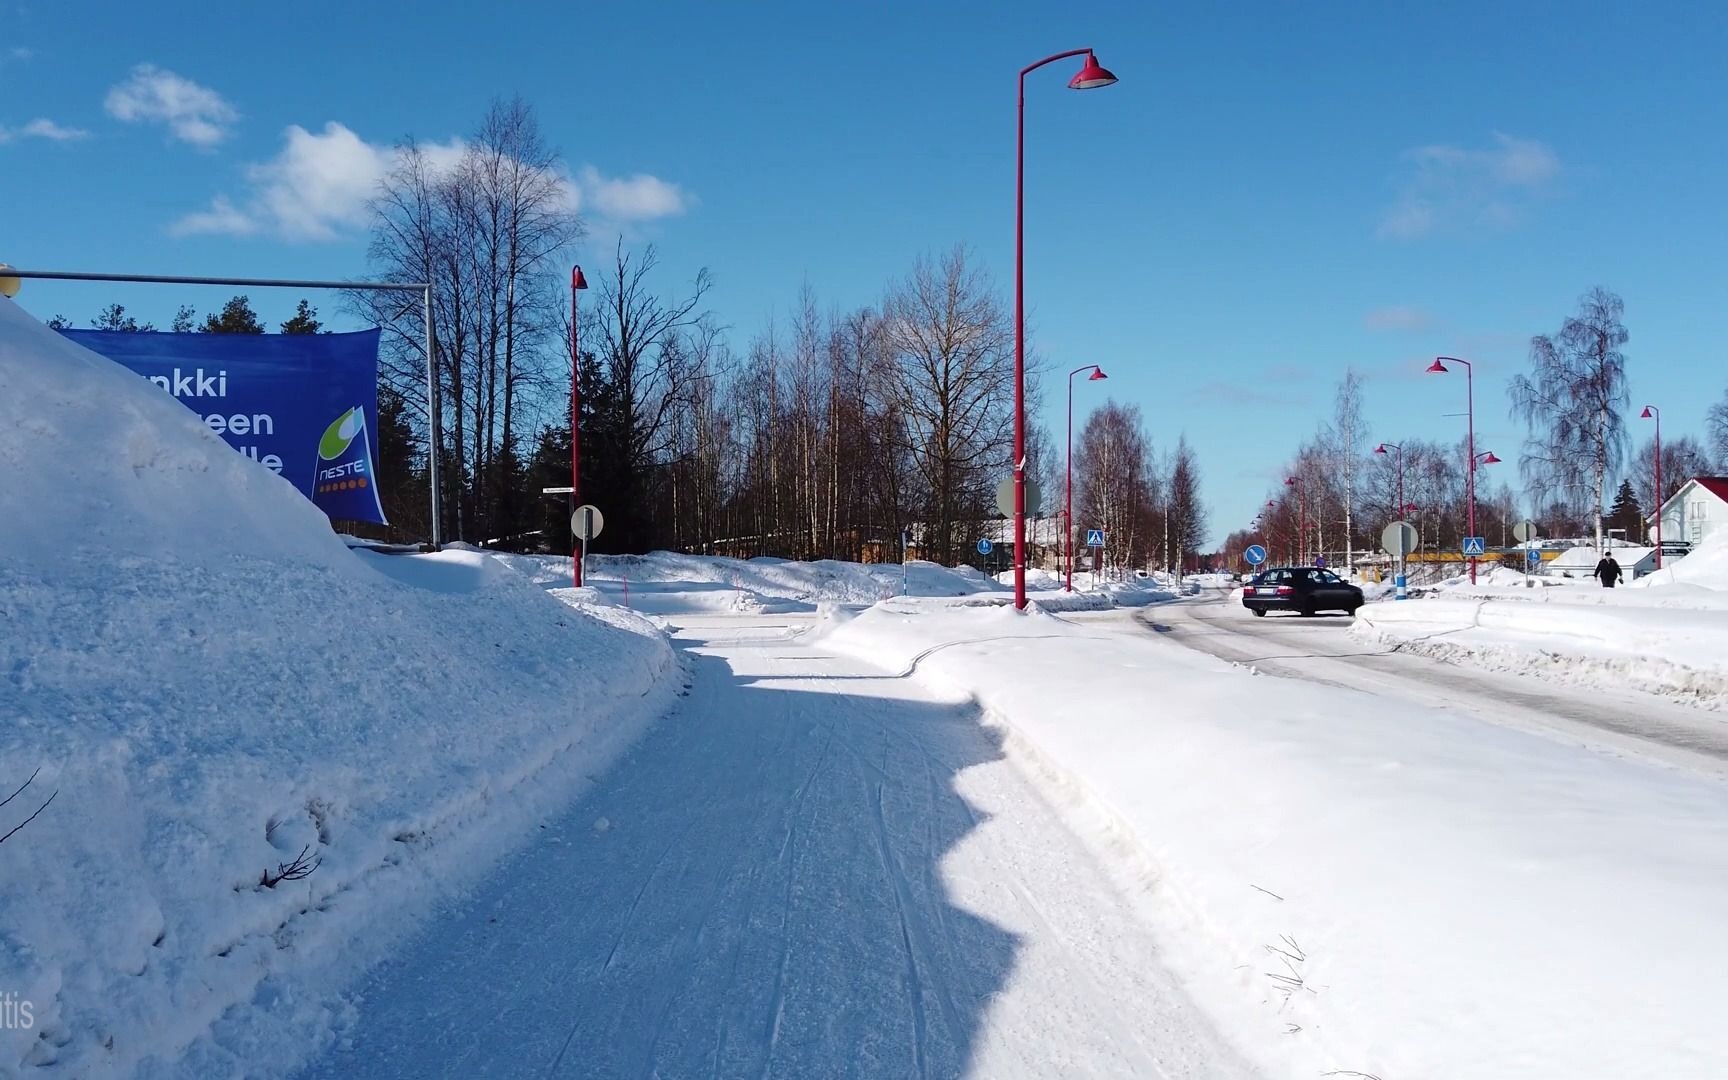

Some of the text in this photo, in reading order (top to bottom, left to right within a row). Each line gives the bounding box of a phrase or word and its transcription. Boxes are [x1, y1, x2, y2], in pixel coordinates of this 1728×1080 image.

[143, 368, 226, 397] nkki
[198, 413, 273, 435] een
[319, 459, 365, 481] NESTE
